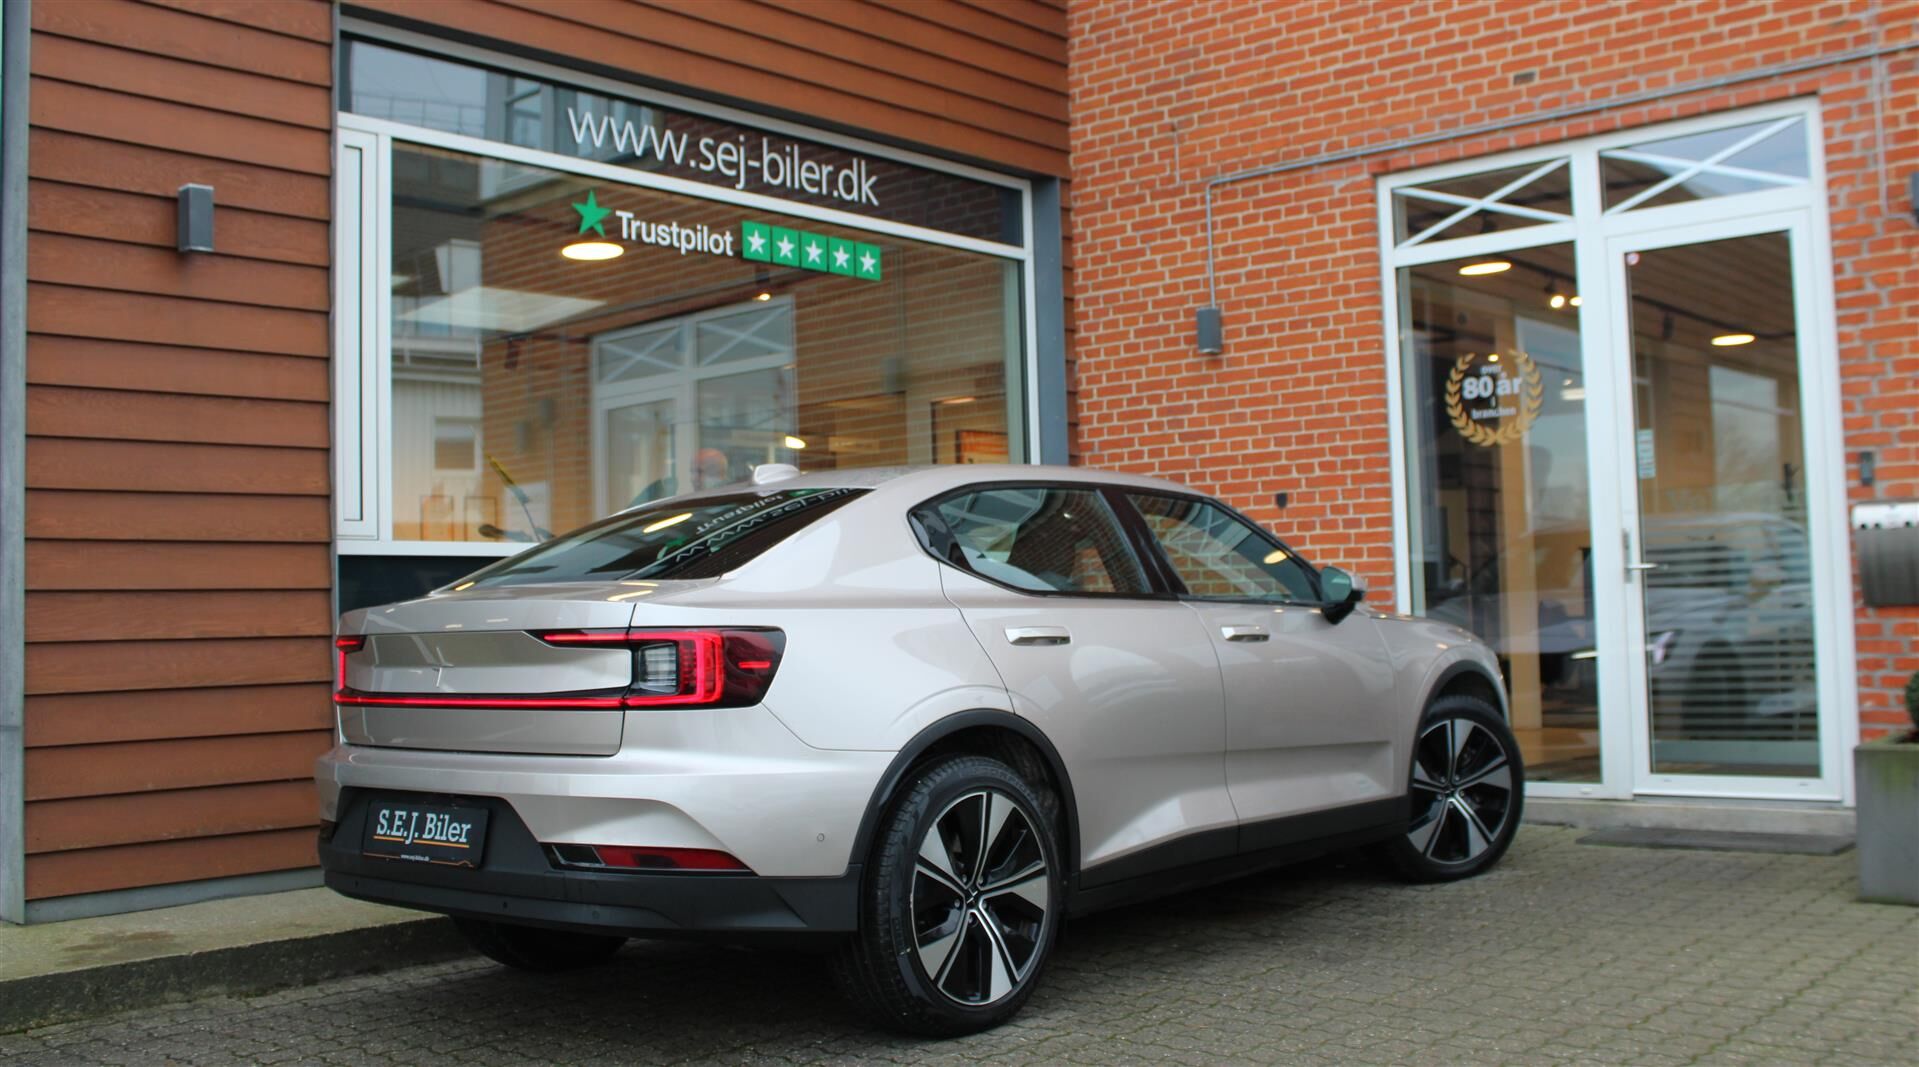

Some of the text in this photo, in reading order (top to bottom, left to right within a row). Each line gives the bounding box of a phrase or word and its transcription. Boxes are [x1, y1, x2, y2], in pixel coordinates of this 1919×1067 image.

[567, 107, 880, 206] www.sej-biler.dk
[615, 210, 734, 257] Trustpilot
[1463, 372, 1522, 399] 80 år
[1471, 406, 1517, 419] branchen
[377, 809, 471, 845] S.E.J. Biler
